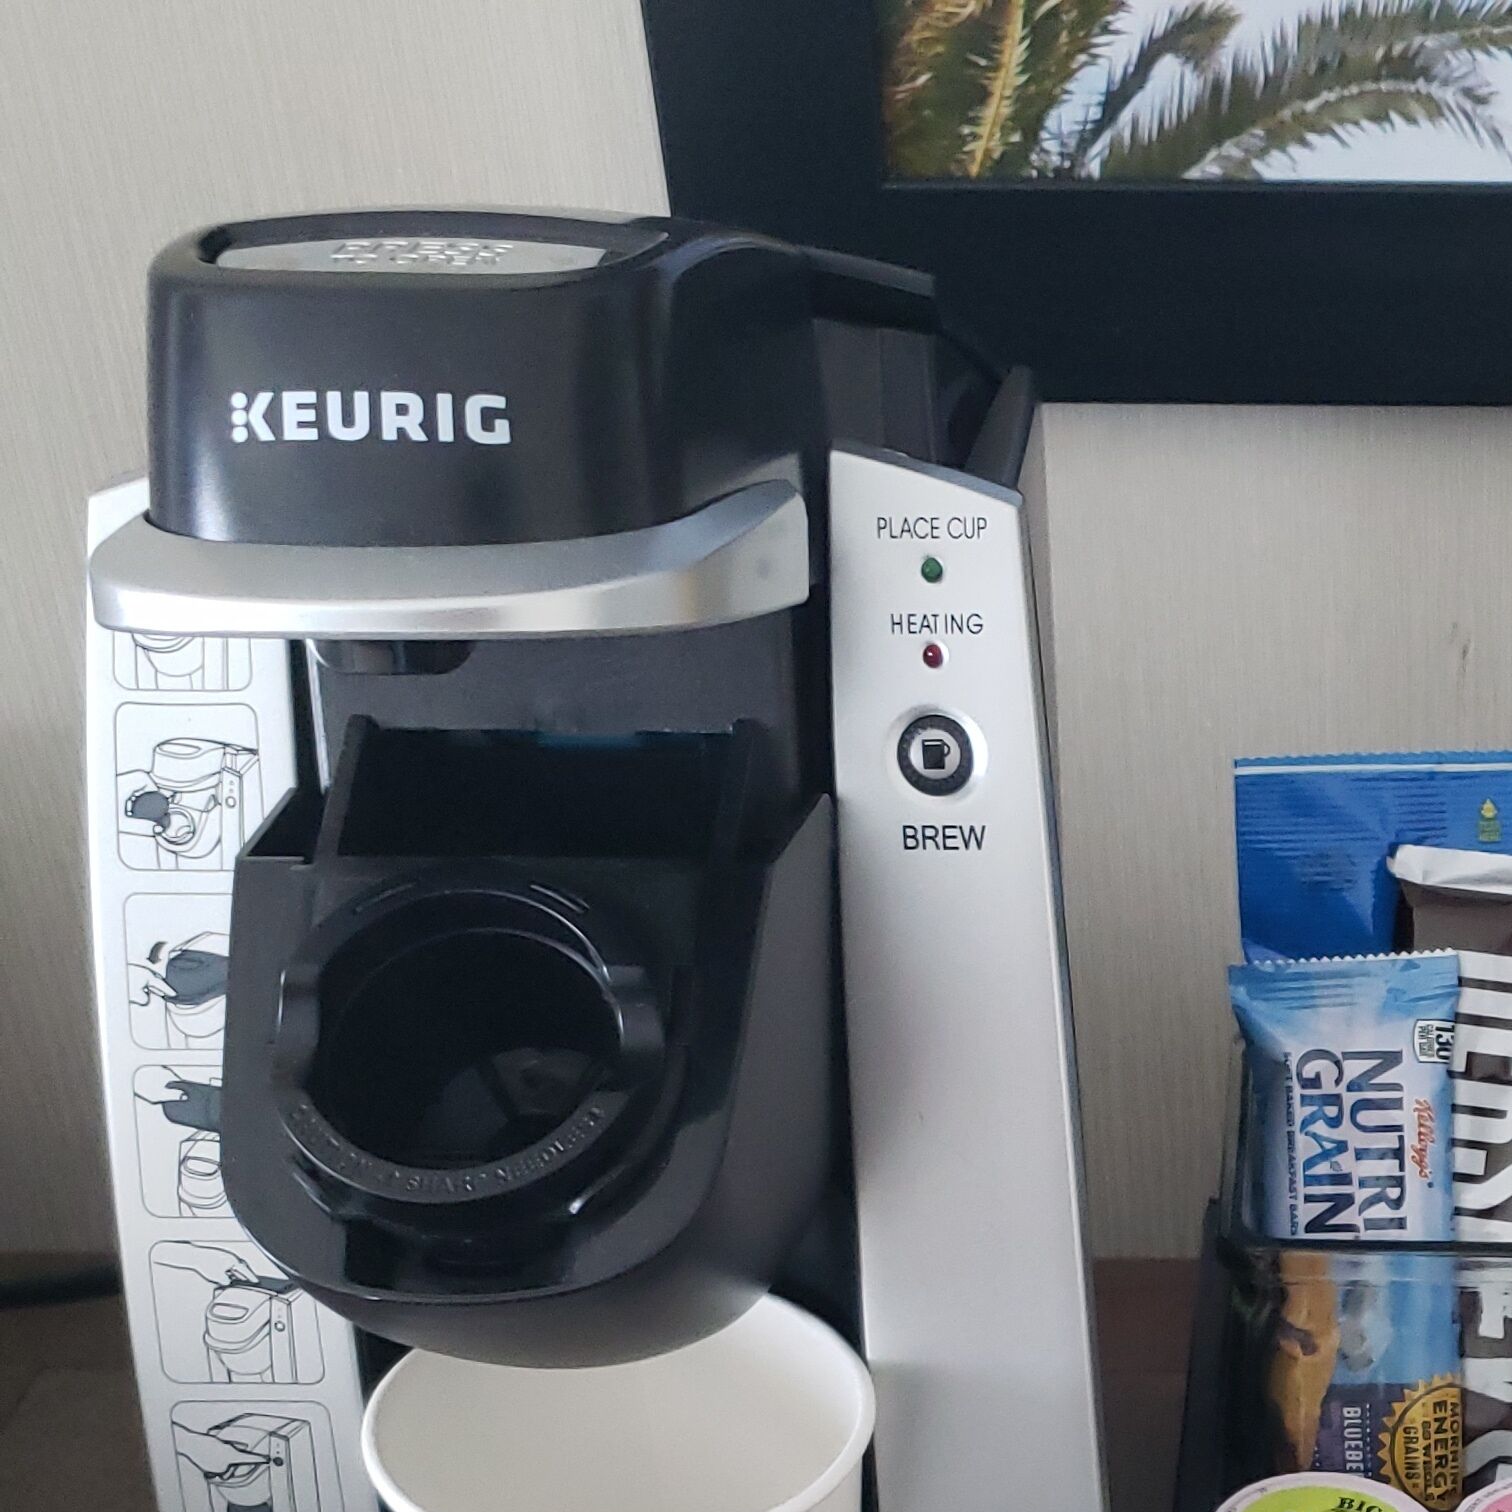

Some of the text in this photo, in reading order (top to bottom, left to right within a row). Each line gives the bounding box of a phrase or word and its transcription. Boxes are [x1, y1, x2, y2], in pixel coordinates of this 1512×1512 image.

[231, 391, 511, 445] KEURIG
[876, 517, 988, 539] PLACE CUP
[890, 613, 984, 635] HEATING
[901, 824, 987, 851] BREW
[1435, 1024, 1455, 1060] 130
[1286, 1130, 1297, 1201] BREAKFAST
[1296, 1048, 1361, 1235] GRAIN
[1341, 1049, 1408, 1232] NUTRI
[1410, 1098, 1436, 1180] Kellogg's
[1342, 1406, 1365, 1478] BLUEBE
[1403, 1425, 1421, 1481] GRAINS
[1433, 1400, 1450, 1501] ENERGY
